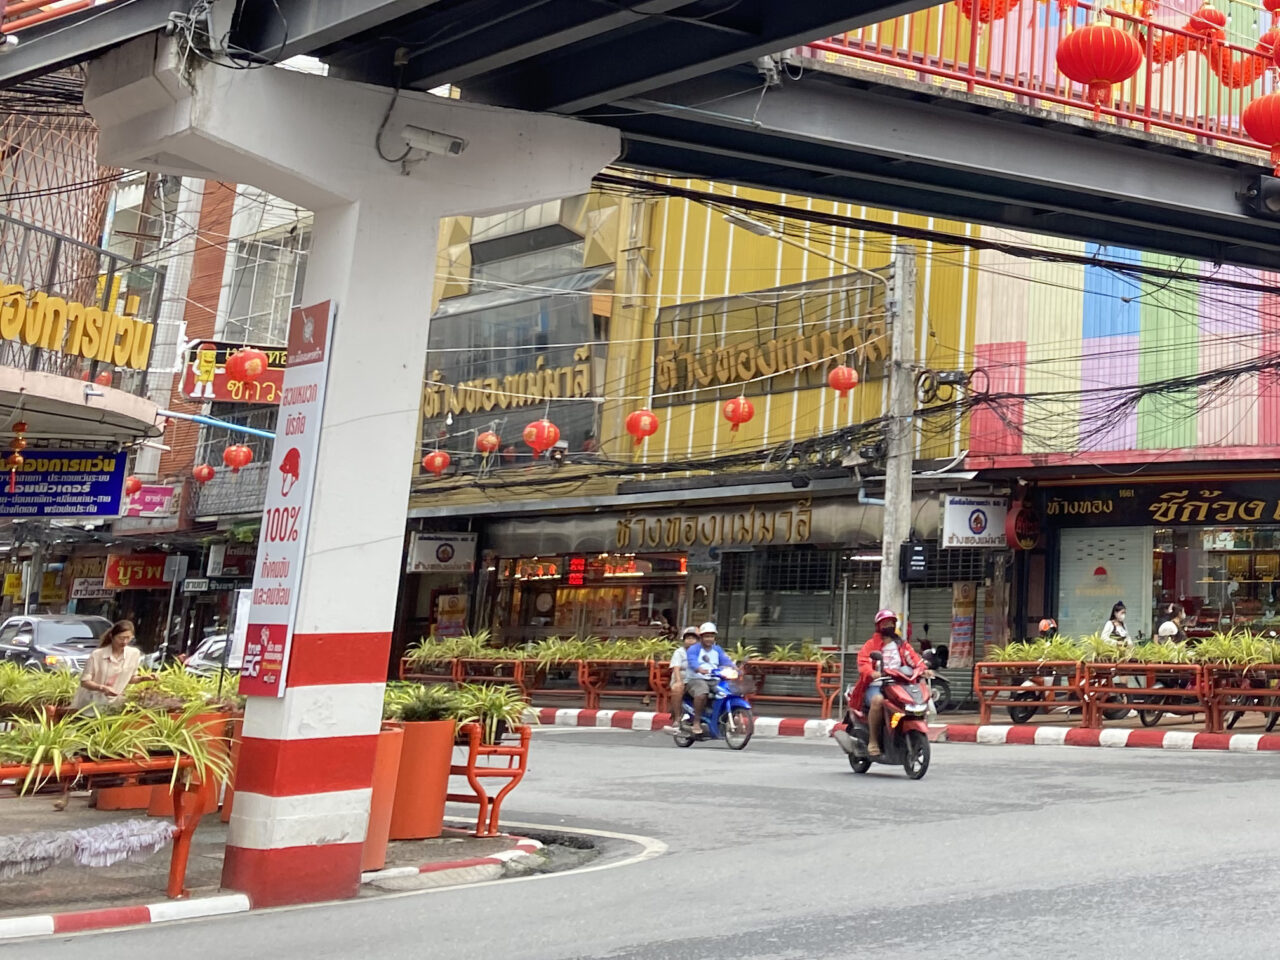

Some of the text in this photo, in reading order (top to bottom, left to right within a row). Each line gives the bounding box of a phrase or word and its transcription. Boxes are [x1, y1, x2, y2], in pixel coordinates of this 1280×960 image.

[1047, 496, 1114, 516] ห้างทอง
[263, 505, 301, 544] 100%
[117, 566, 163, 586] บูรพ
[241, 655, 261, 677] 5G
